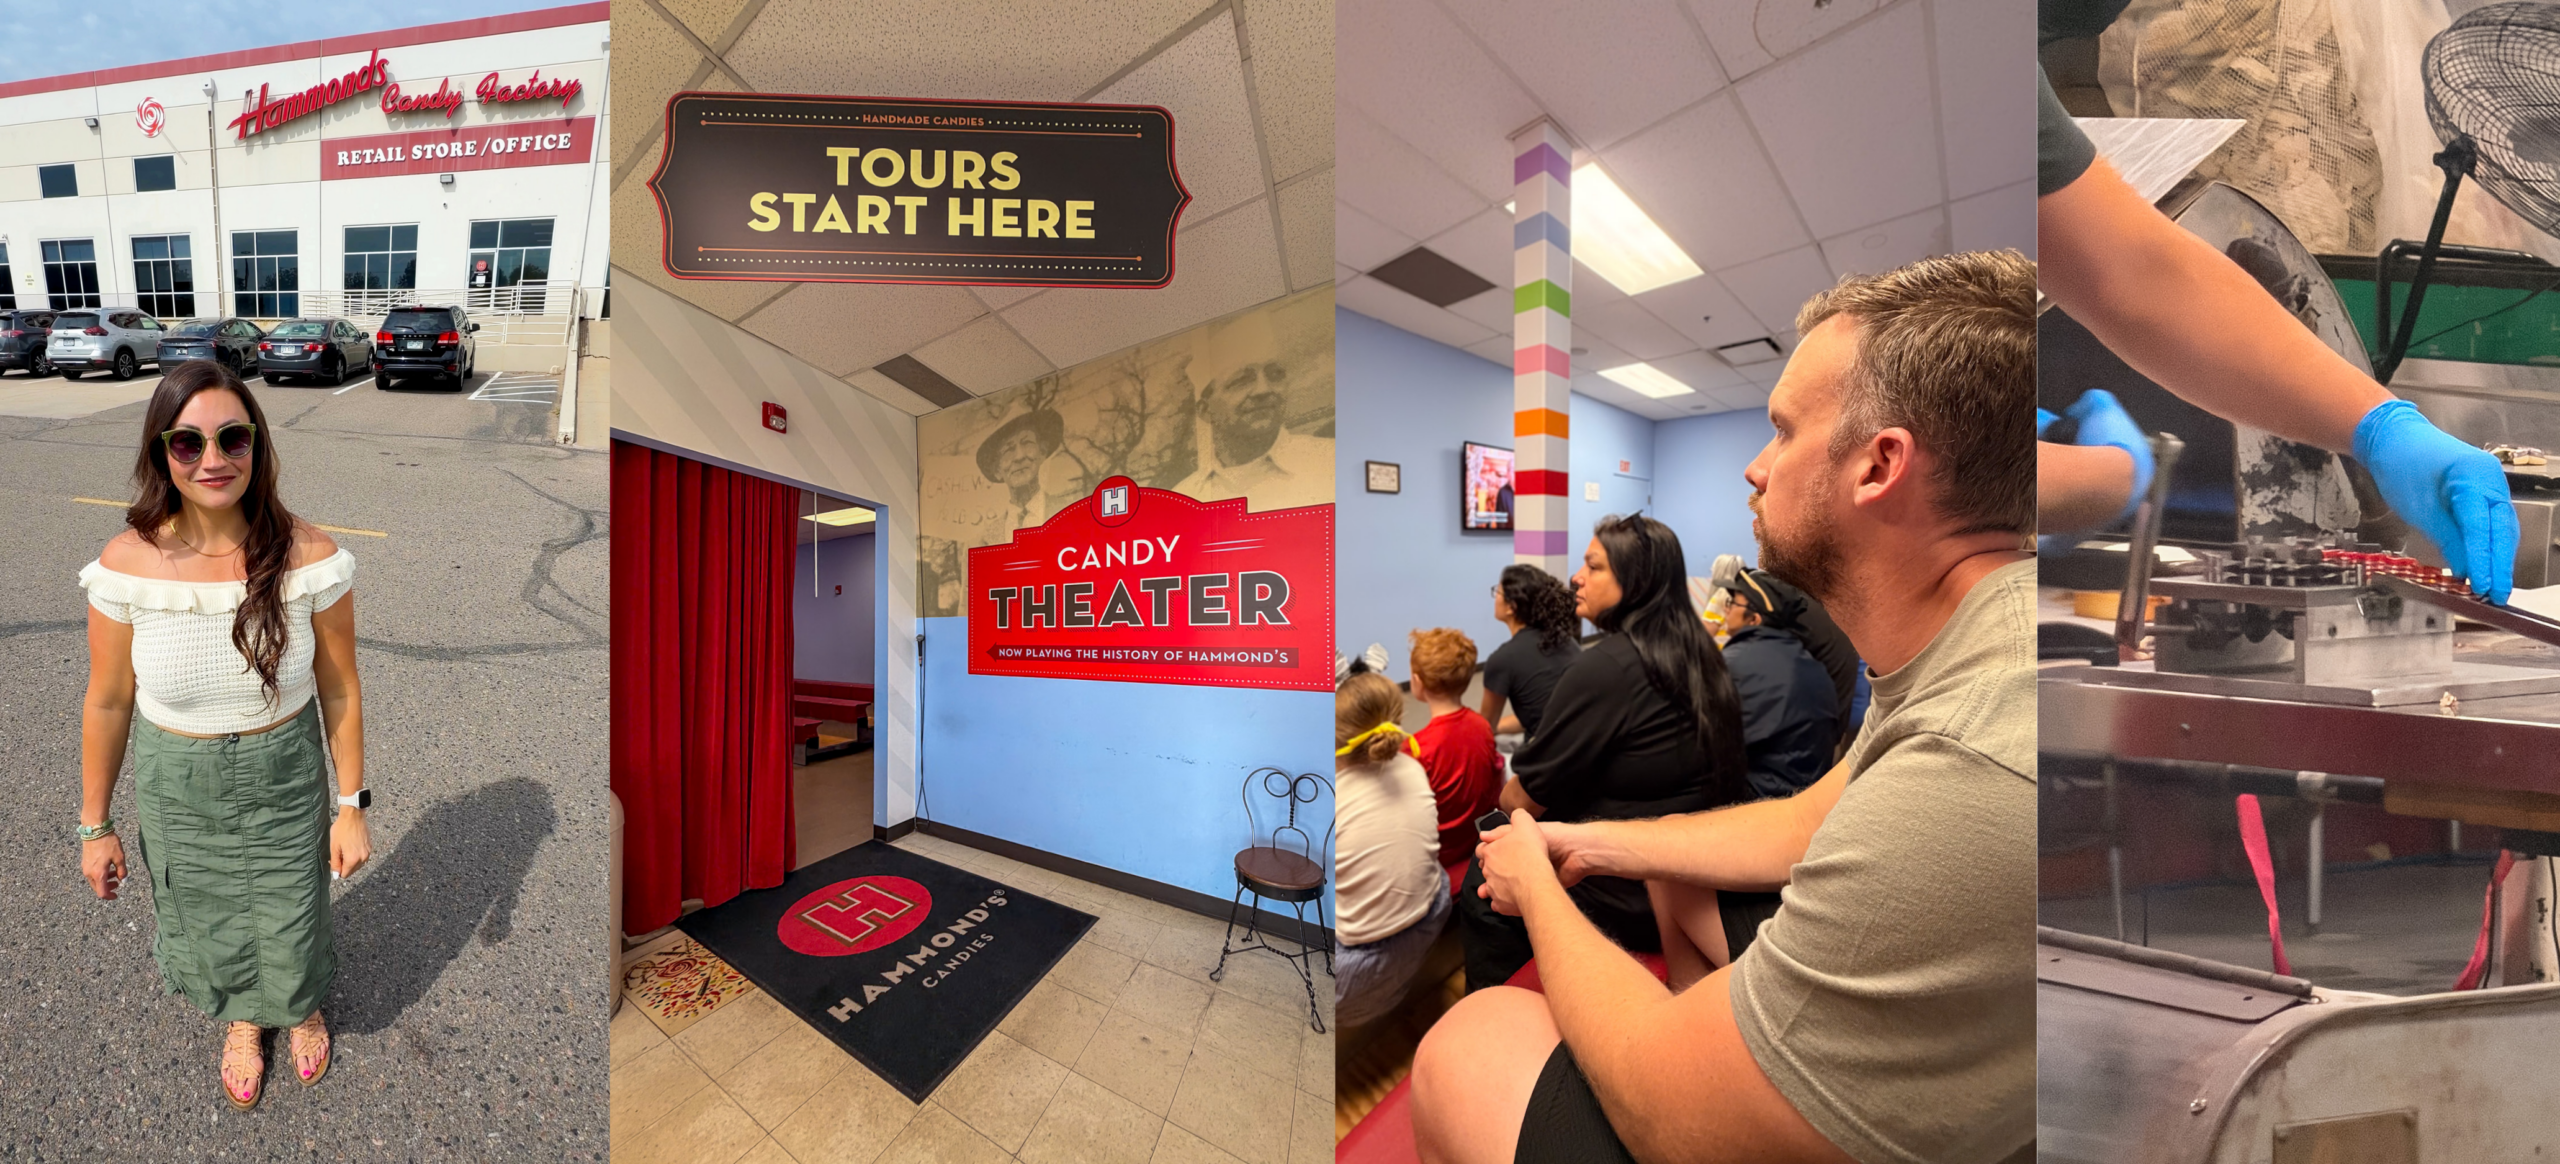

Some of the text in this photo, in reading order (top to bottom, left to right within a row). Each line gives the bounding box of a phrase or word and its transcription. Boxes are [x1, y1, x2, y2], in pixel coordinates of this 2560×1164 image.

[226, 47, 390, 141] Hammonds
[380, 68, 584, 120] Candy Factory
[862, 113, 985, 127] HANDMADE CANDIES
[337, 146, 406, 167] RETAIL
[411, 140, 477, 161] STORE
[826, 146, 1021, 191] TOURS
[747, 191, 1096, 240] START HERE
[1102, 485, 1129, 518] H
[1057, 534, 1181, 572] CANDY
[989, 570, 1294, 631] THEATER
[998, 647, 1289, 664] NOW PLAYING THE HISTORY OF HAMMOND'S
[795, 880, 920, 947] H
[922, 933, 995, 989] CANDIES
